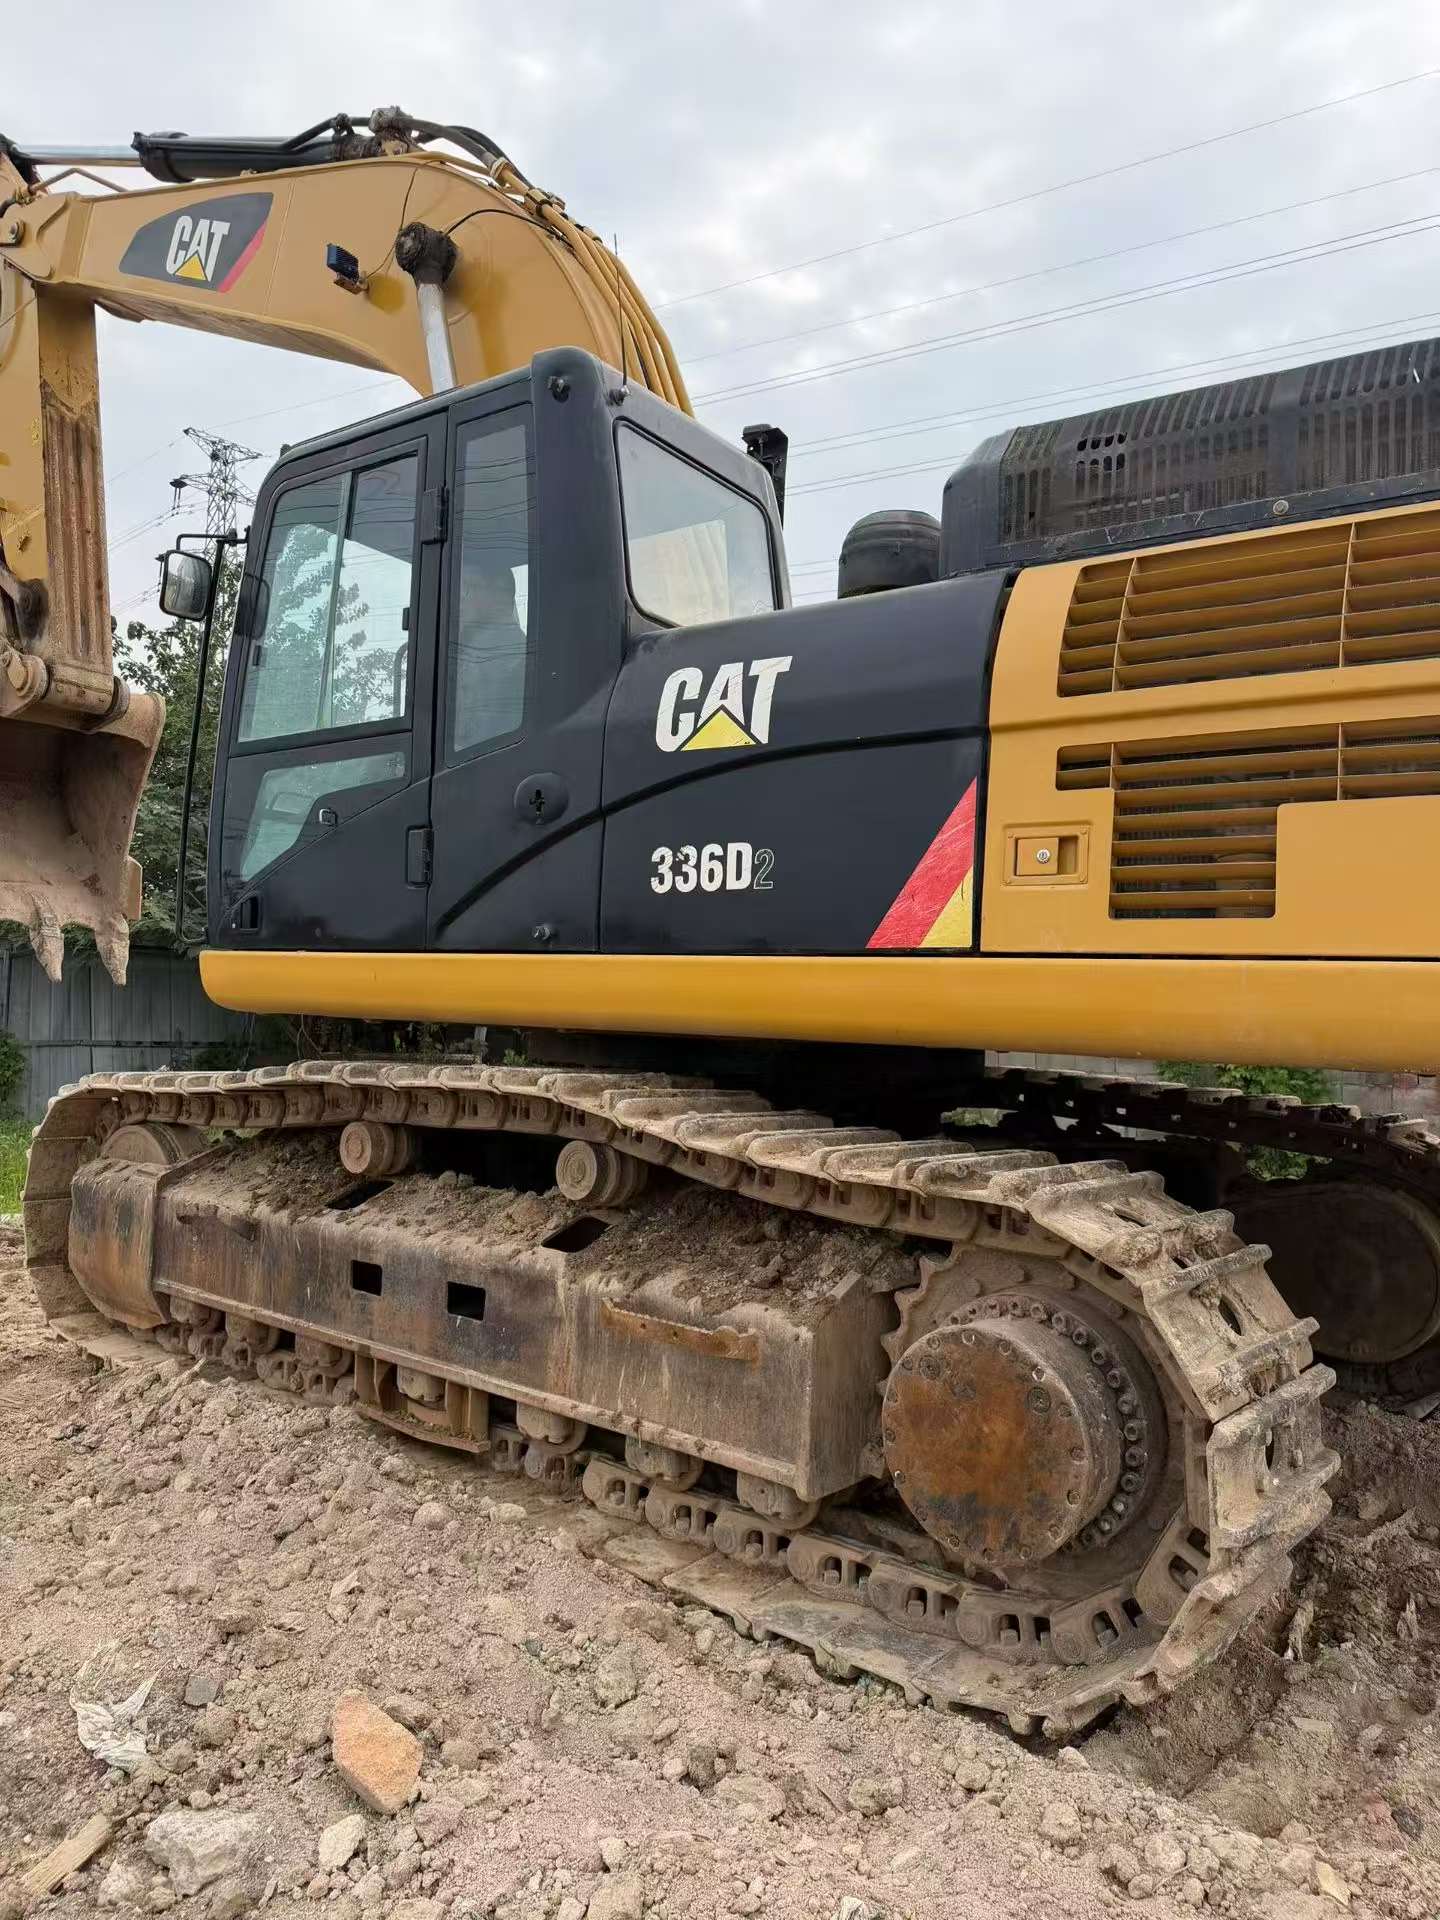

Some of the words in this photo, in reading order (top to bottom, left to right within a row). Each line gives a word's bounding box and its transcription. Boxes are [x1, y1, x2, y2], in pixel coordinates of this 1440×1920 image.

[166, 215, 231, 282] CAT
[655, 655, 793, 752] CAT
[650, 841, 775, 894] 336D2
